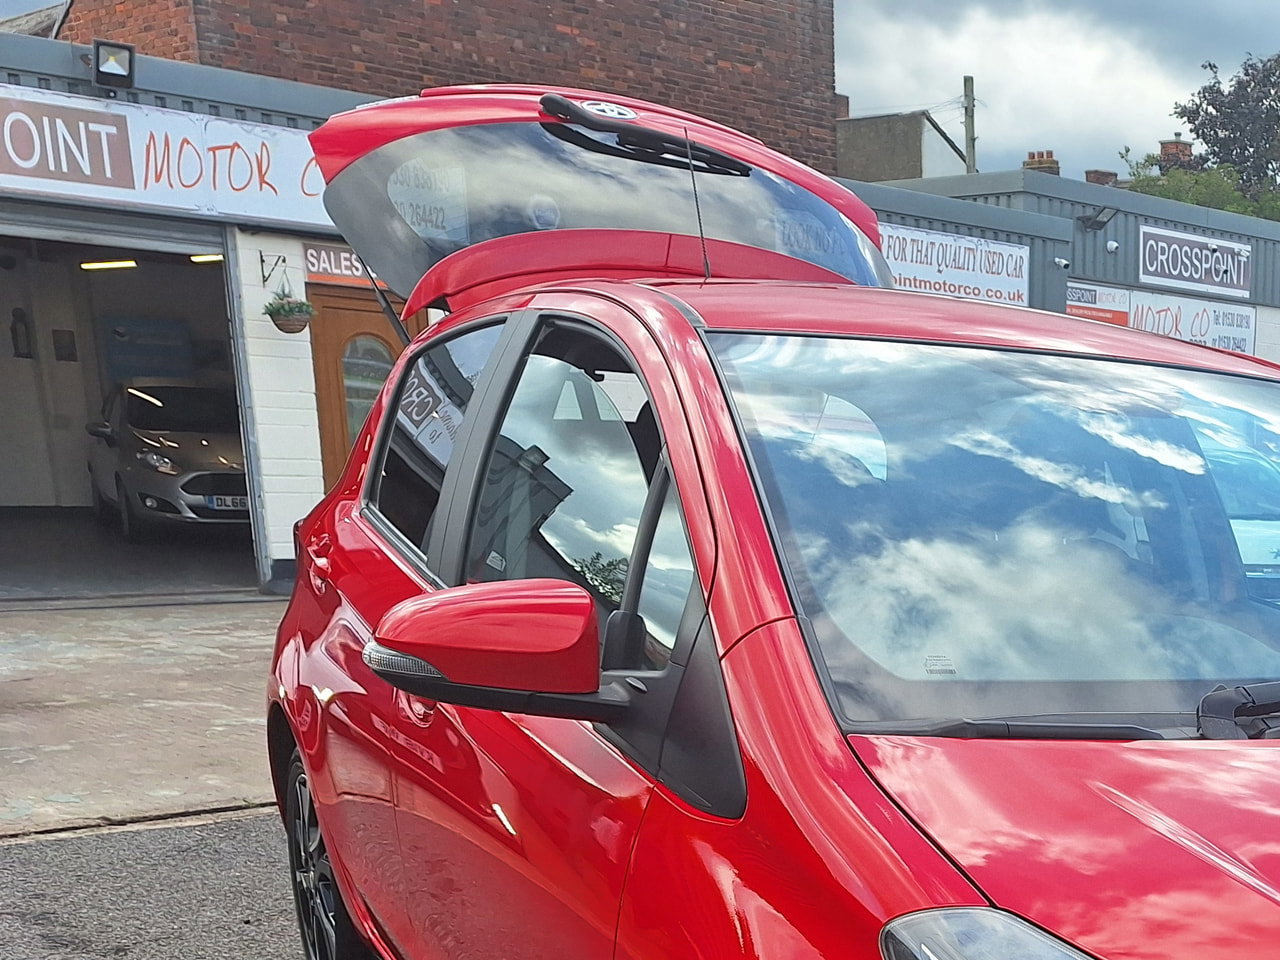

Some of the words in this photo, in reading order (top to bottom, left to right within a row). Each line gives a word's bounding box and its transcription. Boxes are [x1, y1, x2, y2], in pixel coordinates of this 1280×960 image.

[143, 130, 278, 197] MOTOR
[300, 156, 321, 197] C
[306, 248, 363, 277] SALES
[886, 234, 908, 263] FOR
[910, 238, 936, 266] THAT
[937, 242, 978, 274] QUALITY
[979, 247, 1005, 276] USED
[1005, 253, 1024, 280] CAR
[1145, 239, 1248, 286] CROSSPOINT
[1132, 303, 1182, 337] MOTOR
[1190, 307, 1210, 338] CO
[215, 497, 248, 508] DL66
